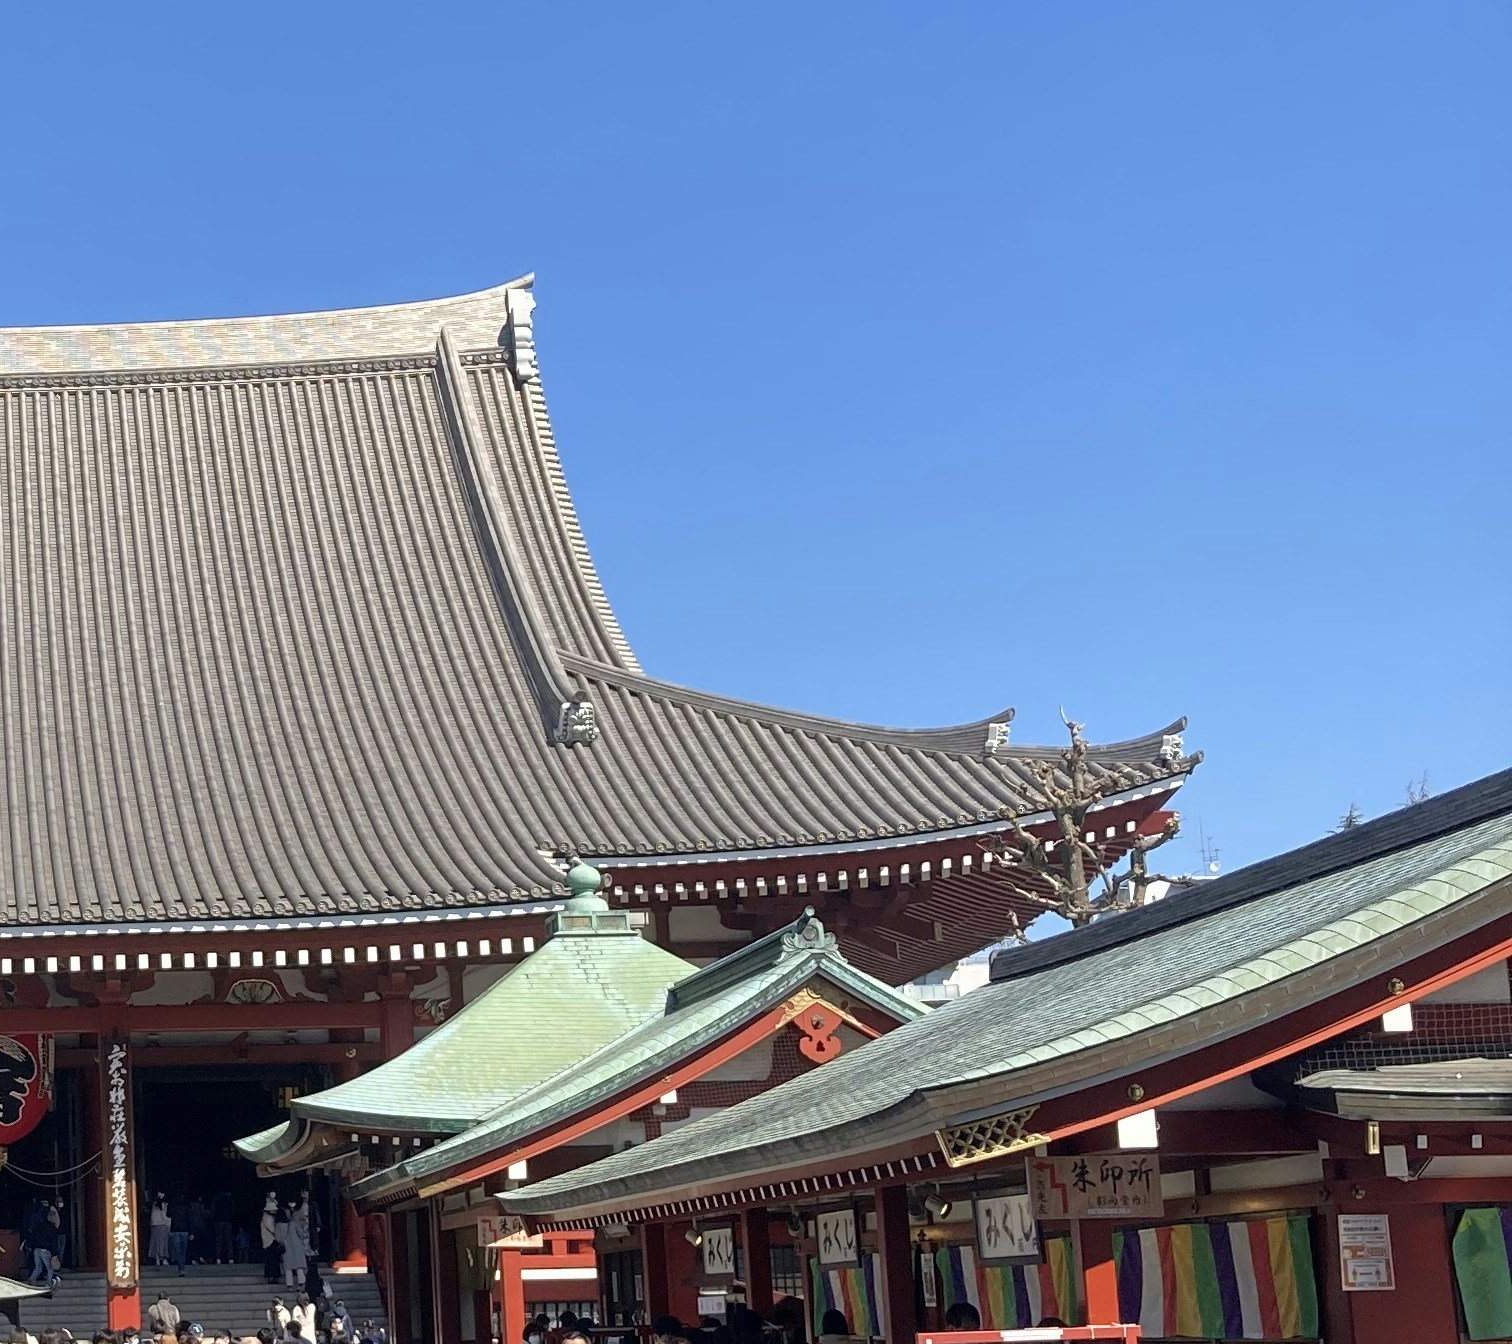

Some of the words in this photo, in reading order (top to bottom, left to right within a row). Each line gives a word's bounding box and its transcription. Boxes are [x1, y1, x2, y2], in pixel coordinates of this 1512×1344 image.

[1071, 1158, 1153, 1195] 朱印所
[823, 1217, 854, 1256] みくじ
[985, 1202, 1033, 1249] みくじ
[708, 1234, 732, 1267] みくじ
